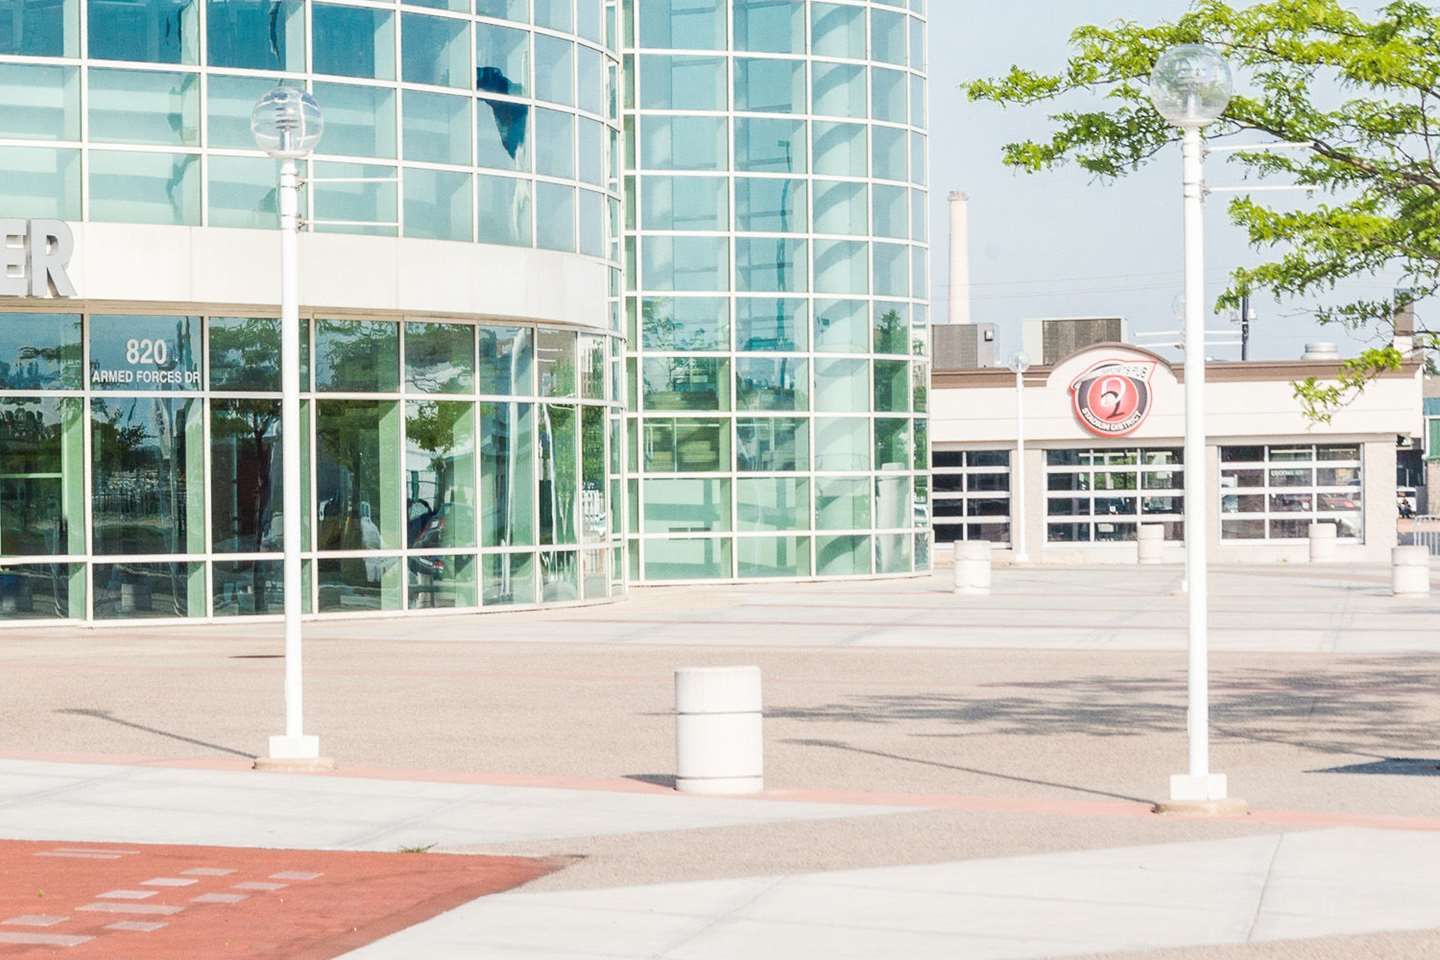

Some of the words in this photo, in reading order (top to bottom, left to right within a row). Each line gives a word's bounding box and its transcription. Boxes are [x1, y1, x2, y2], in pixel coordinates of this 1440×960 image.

[126, 339, 168, 365] 820
[92, 370, 134, 383] ARMED
[136, 371, 182, 383] FORCES
[184, 371, 201, 383] DR
